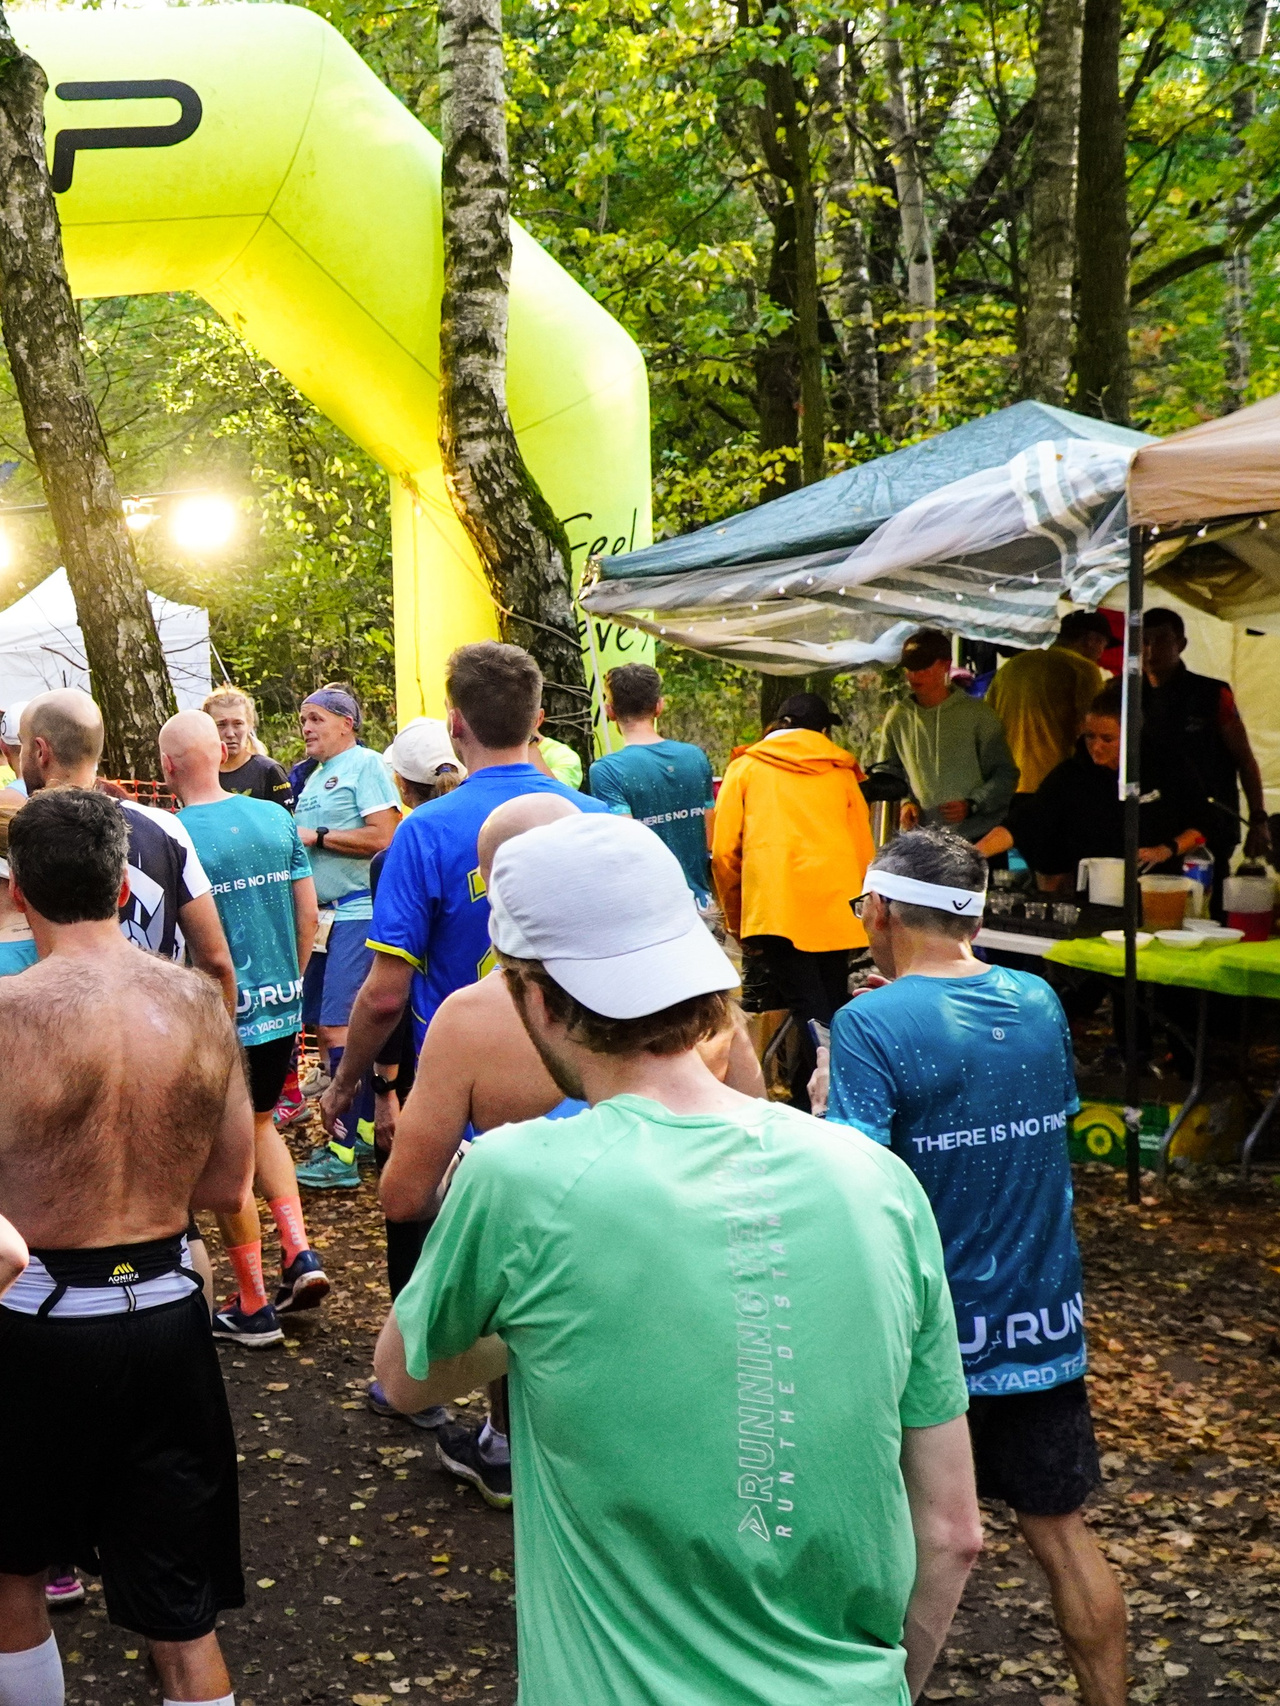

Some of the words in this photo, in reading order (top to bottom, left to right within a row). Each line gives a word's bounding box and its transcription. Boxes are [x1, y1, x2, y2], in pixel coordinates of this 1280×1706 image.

[673, 809, 689, 820] NO
[233, 878, 247, 891] IS
[248, 874, 266, 888] NO
[258, 976, 305, 1008] RUN
[237, 1018, 284, 1038] CKYARD
[912, 1127, 987, 1154] THERE
[990, 1123, 1007, 1143] IS
[1010, 1117, 1040, 1139] NO
[1006, 1291, 1084, 1349] RUN
[735, 1288, 775, 1503] RUNNING
[970, 1366, 1057, 1392] KYARD
[778, 1381, 796, 1449] THE
[775, 1471, 796, 1539] RUN
